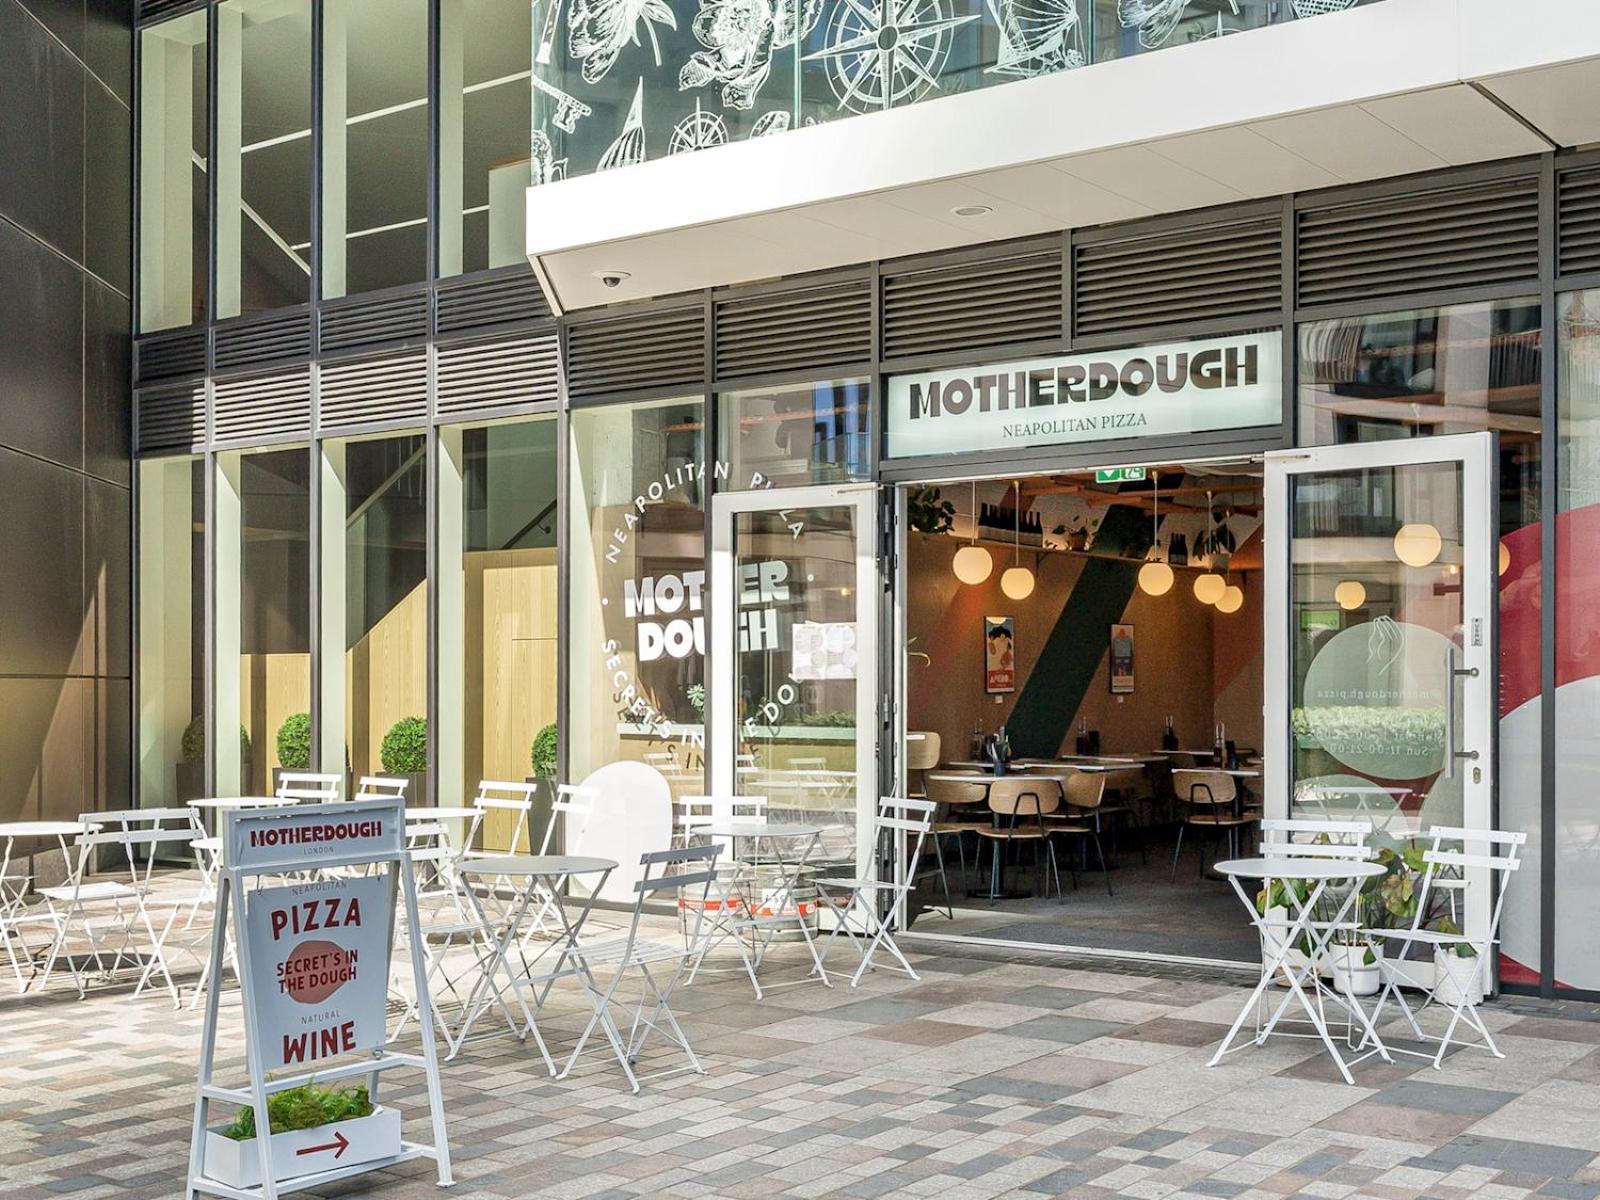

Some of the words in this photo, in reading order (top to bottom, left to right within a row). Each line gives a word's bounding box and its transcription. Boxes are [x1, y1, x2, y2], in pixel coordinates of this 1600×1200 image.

[909, 344, 1259, 420] MOTHERDOUGH
[1002, 416, 1097, 438] NEAPOLITAN
[1101, 413, 1148, 429] PIZZA
[624, 560, 790, 618] MOTER
[250, 820, 383, 847] MOTHERDOUGH
[303, 846, 335, 856] LONDON
[292, 880, 347, 896] NEAPOLITAN
[271, 898, 361, 941] PIZZA
[276, 953, 342, 977] SECRET'S
[345, 949, 358, 964] IN
[278, 976, 305, 994] THE
[309, 966, 357, 988] DOUGH
[301, 1010, 341, 1025] NATURAL
[283, 1020, 357, 1065] WINE
